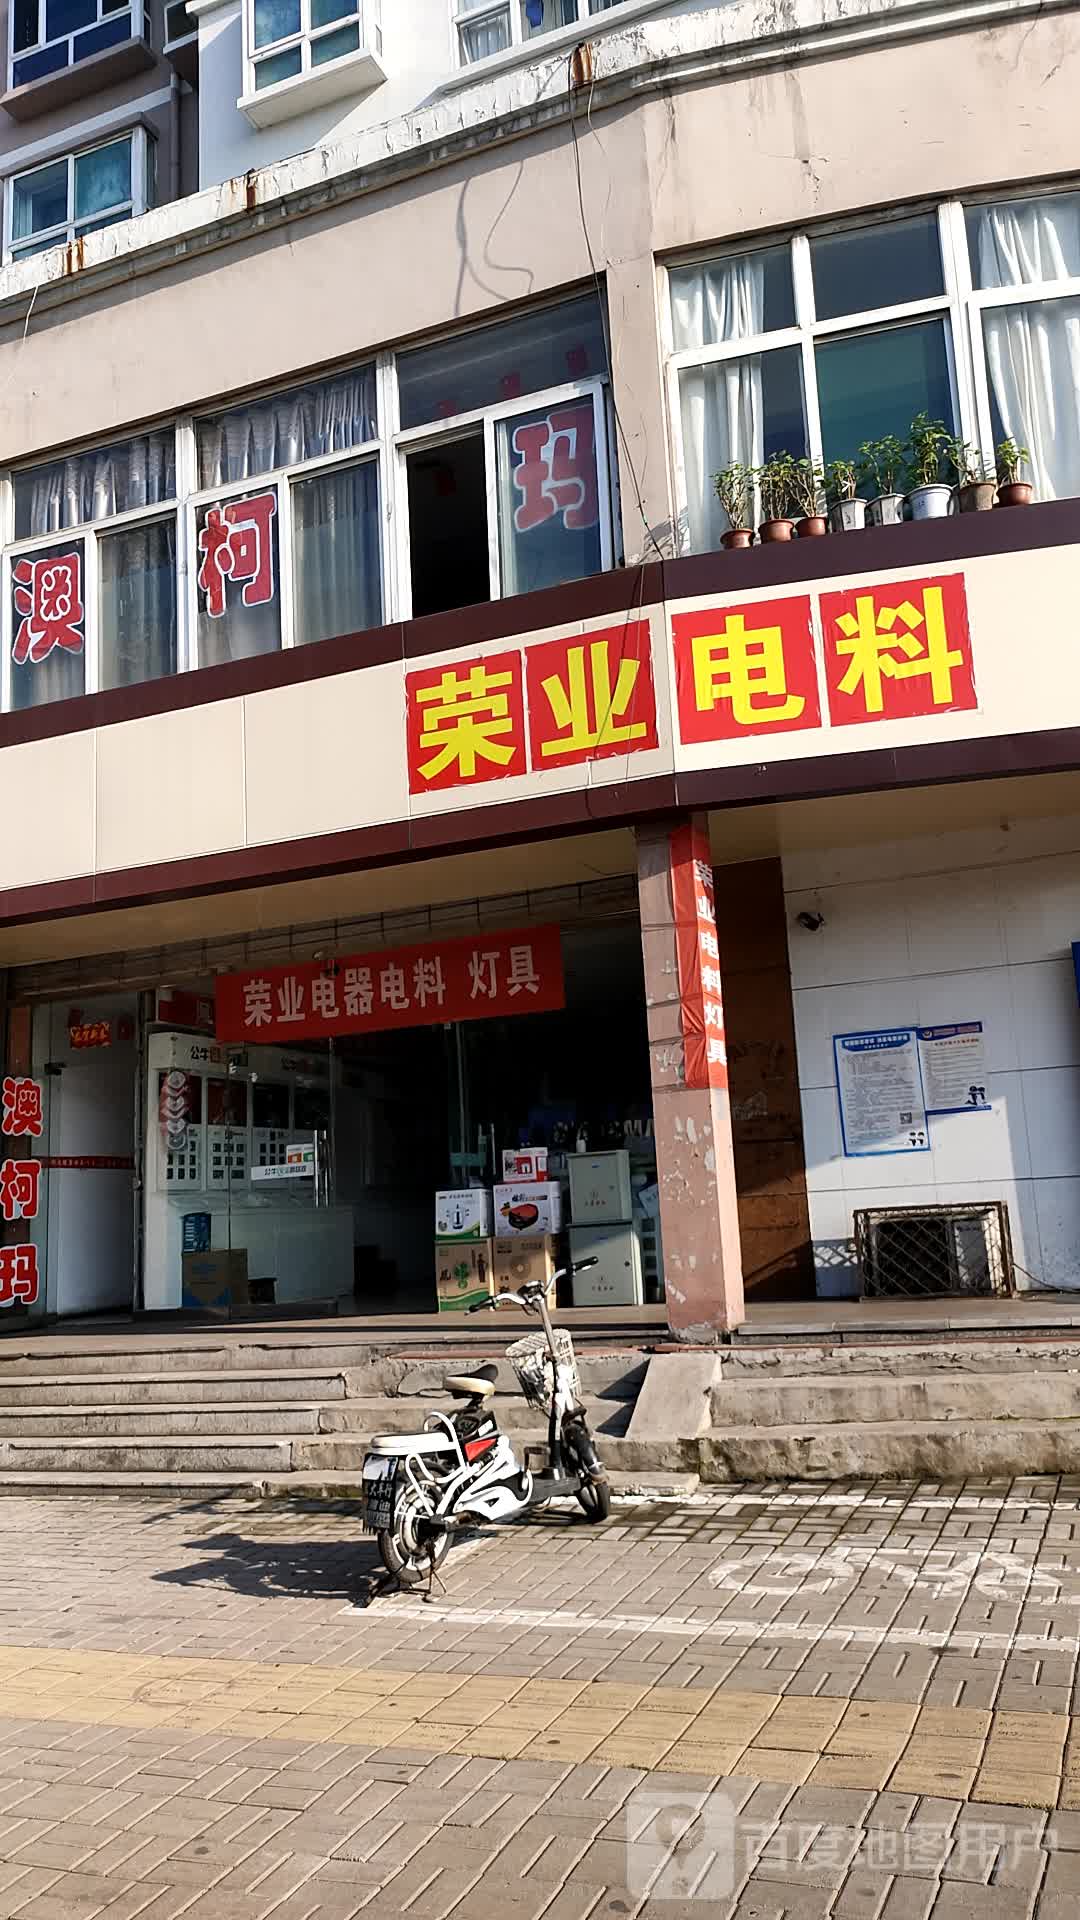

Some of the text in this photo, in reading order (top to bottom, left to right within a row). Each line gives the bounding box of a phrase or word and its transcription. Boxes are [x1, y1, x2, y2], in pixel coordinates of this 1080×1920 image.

[12, 403, 600, 665] 澳 柯 玛
[416, 586, 963, 779] 荣业电料
[242, 944, 541, 1028] 荣业电器电料 灯具
[694, 859, 728, 1066] 荣业电料灯具
[0, 1077, 43, 1306] 澳柯玛
